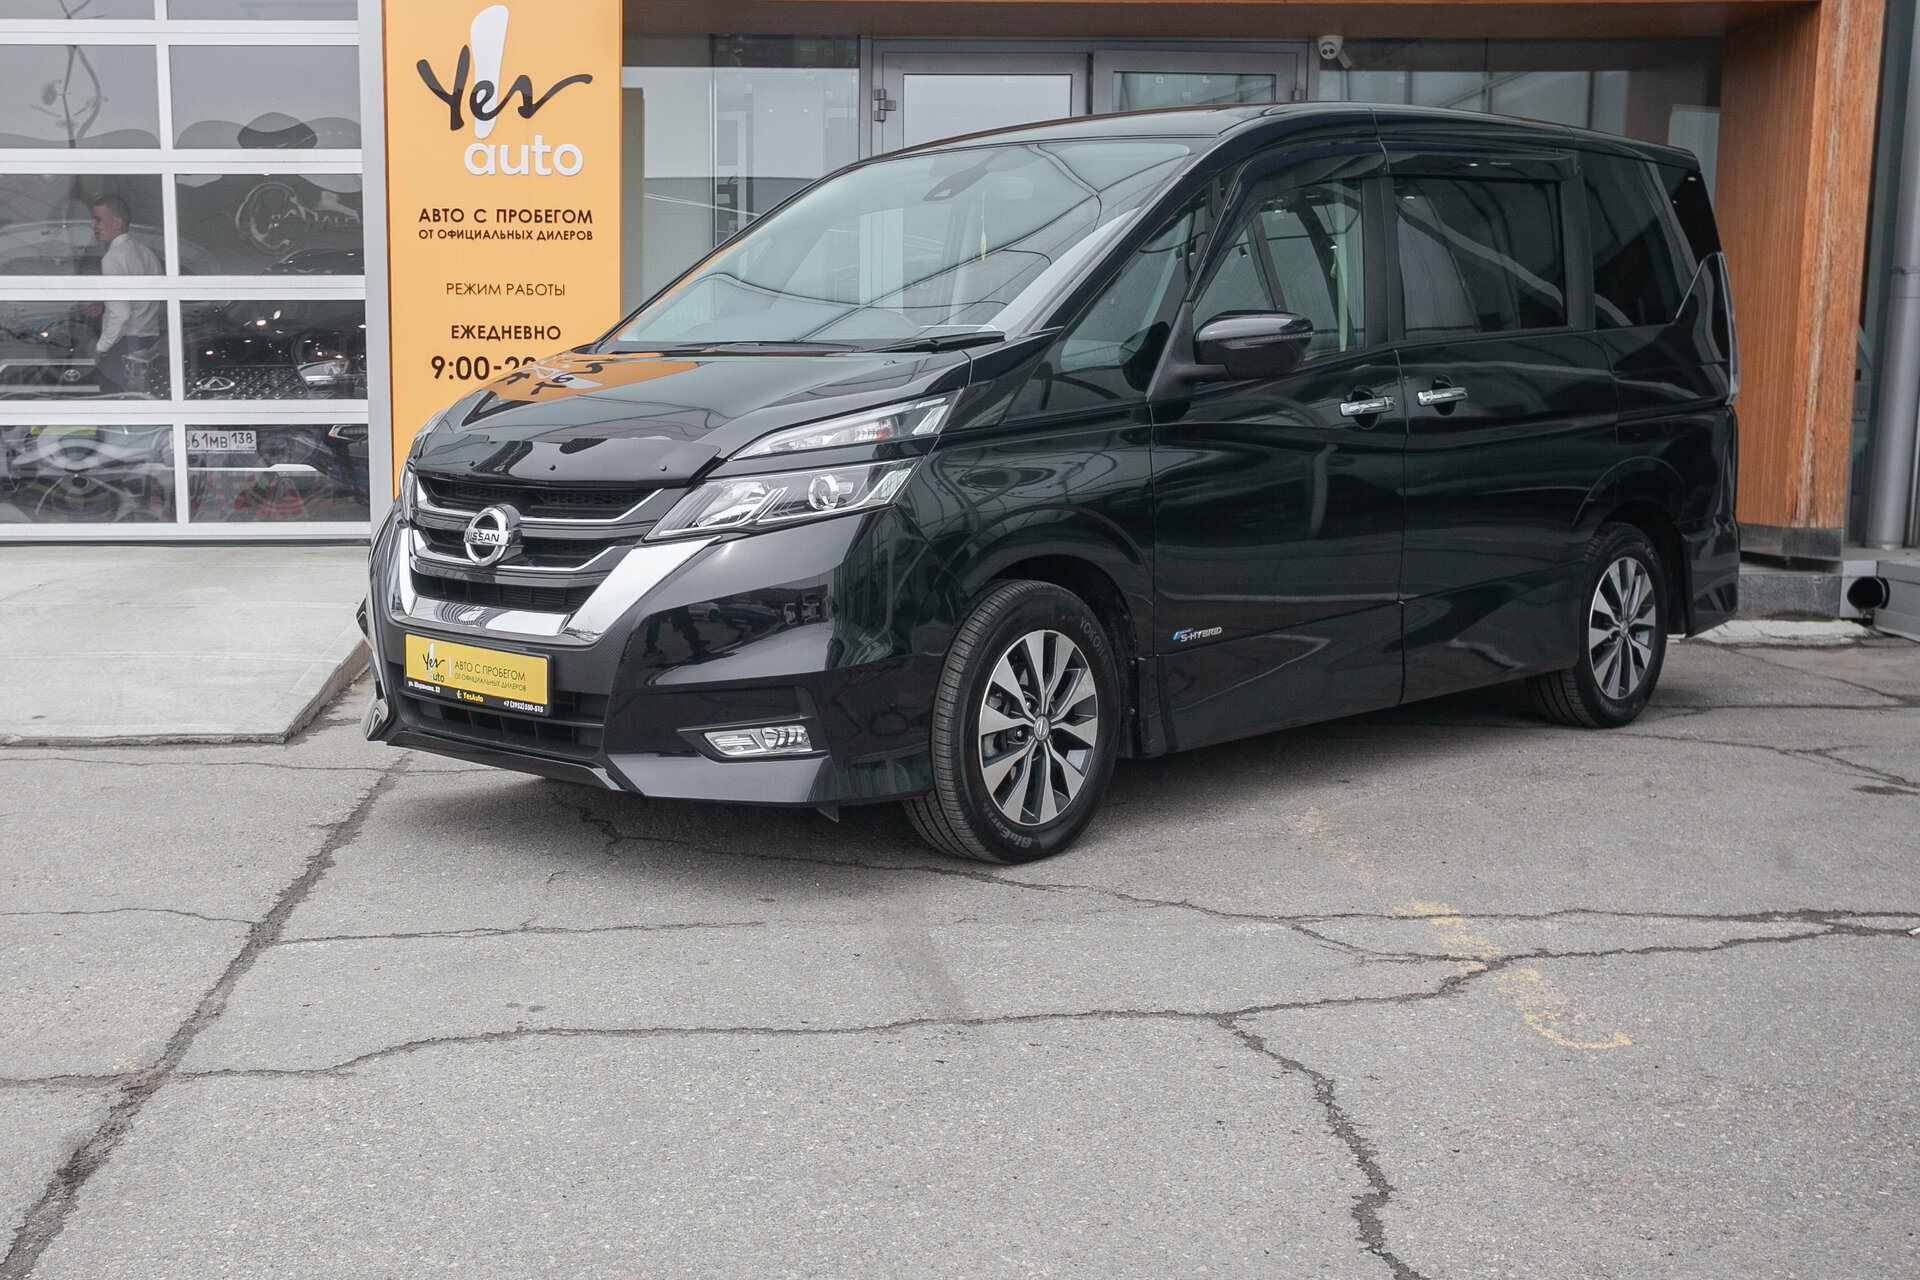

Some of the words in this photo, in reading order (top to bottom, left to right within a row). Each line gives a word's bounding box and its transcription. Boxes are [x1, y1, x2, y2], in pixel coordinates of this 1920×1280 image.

[416, 44, 593, 131] Yes
[464, 134, 584, 176] auto
[418, 208, 465, 223] АВТО
[473, 208, 487, 223] С
[496, 209, 593, 224] ПРОБЕГОМ
[418, 229, 434, 240] ОТ
[437, 229, 533, 241] ОФИЦИАЛЬНЫХ
[536, 230, 593, 241] ДИЛЕРОВ
[446, 283, 502, 296] РЕЖИМ
[506, 283, 566, 296] РАБОТЫ
[451, 325, 561, 341] ЕЖЕДНЕВНО
[231, 432, 254, 445] 138
[466, 530, 500, 543] NISSAN
[1180, 626, 1223, 642] S-HYBRID
[454, 660, 473, 673] АВТО
[474, 663, 481, 674] С
[482, 664, 526, 682] ПРОБЕГОМ
